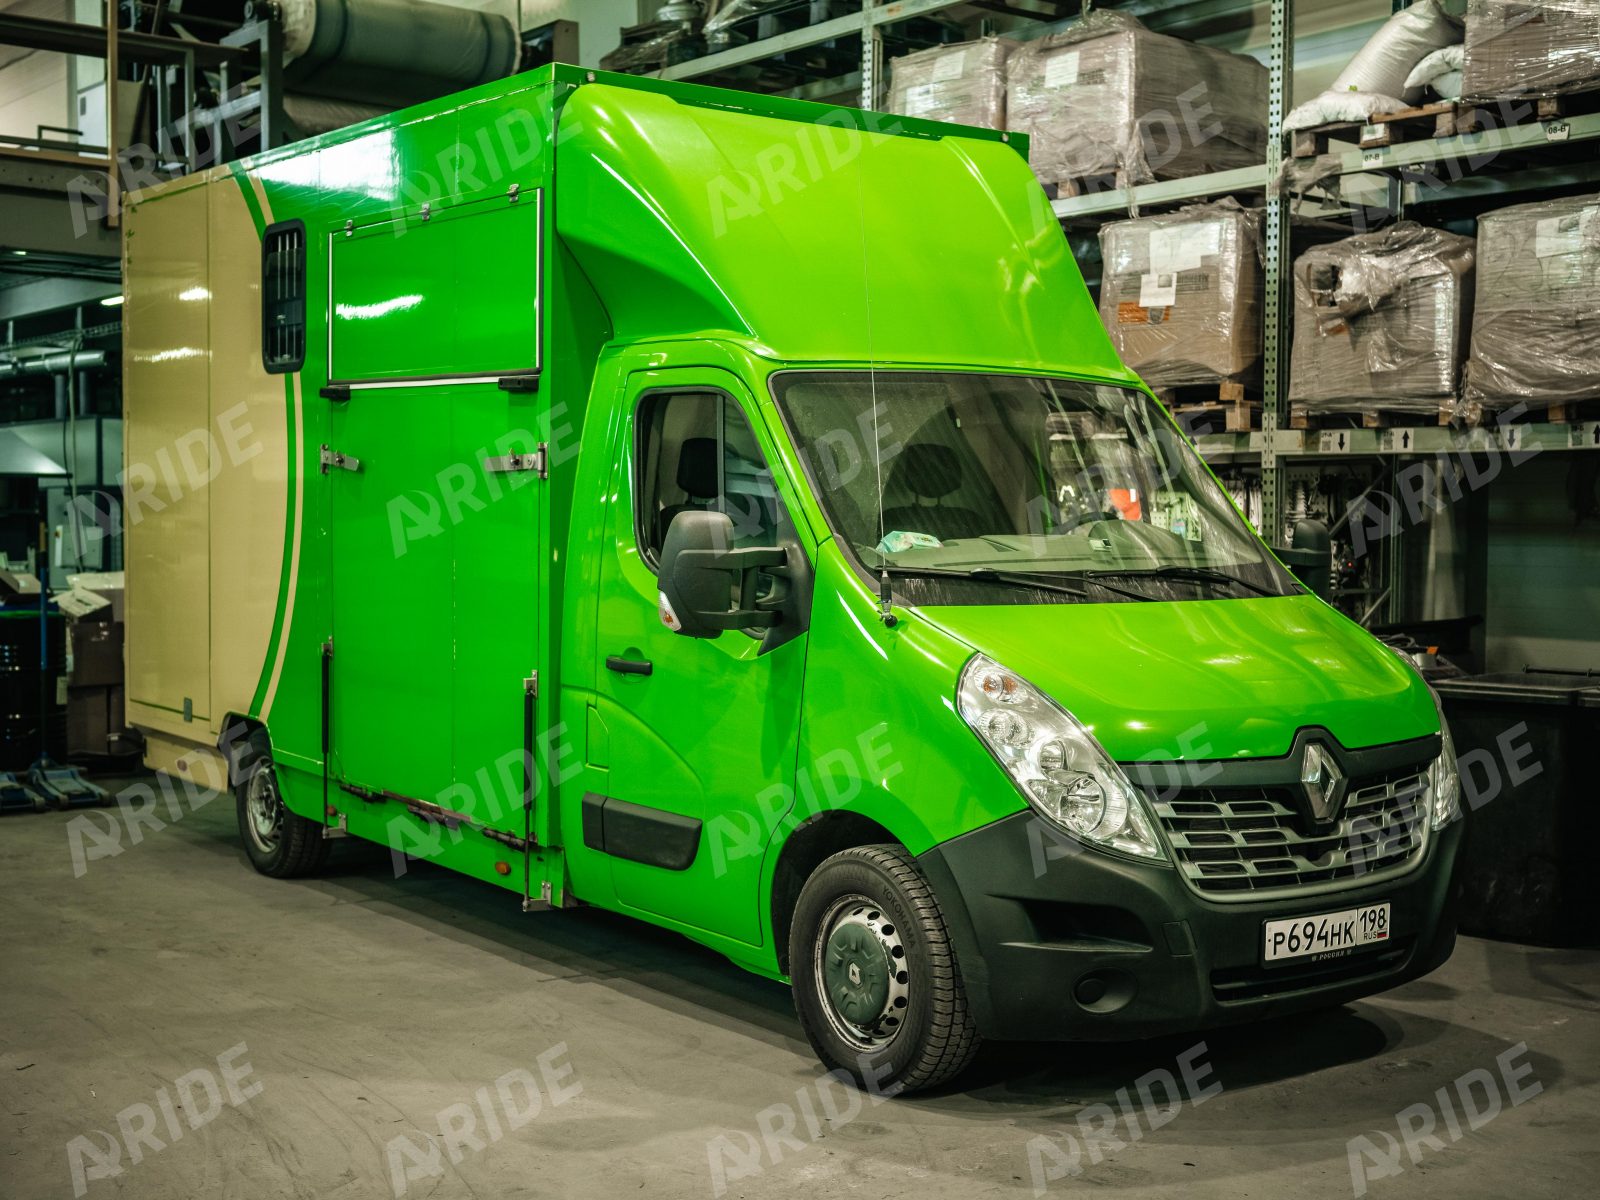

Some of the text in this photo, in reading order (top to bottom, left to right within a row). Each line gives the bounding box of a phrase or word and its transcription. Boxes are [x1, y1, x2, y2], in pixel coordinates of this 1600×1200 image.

[882, 885, 917, 949] YOKOHAMA
[1360, 907, 1387, 932] 198
[1363, 931, 1377, 940] RUS
